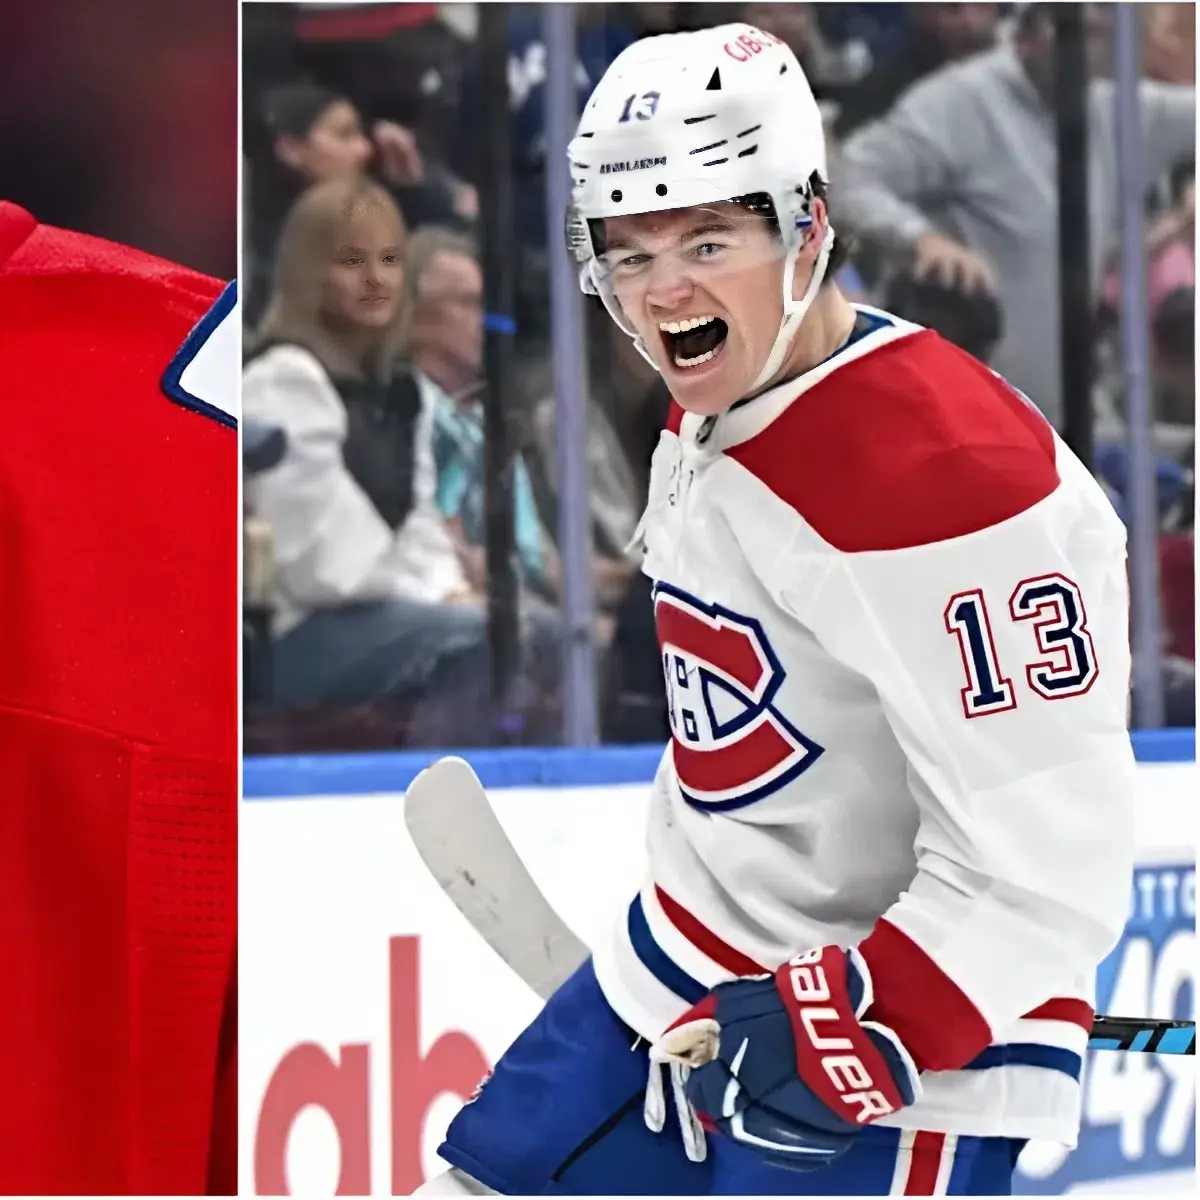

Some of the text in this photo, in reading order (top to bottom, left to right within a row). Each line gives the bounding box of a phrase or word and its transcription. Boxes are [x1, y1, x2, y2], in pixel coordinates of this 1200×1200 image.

[618, 90, 661, 122] 13
[944, 572, 1099, 718] 13
[788, 947, 894, 1123] BAUER
